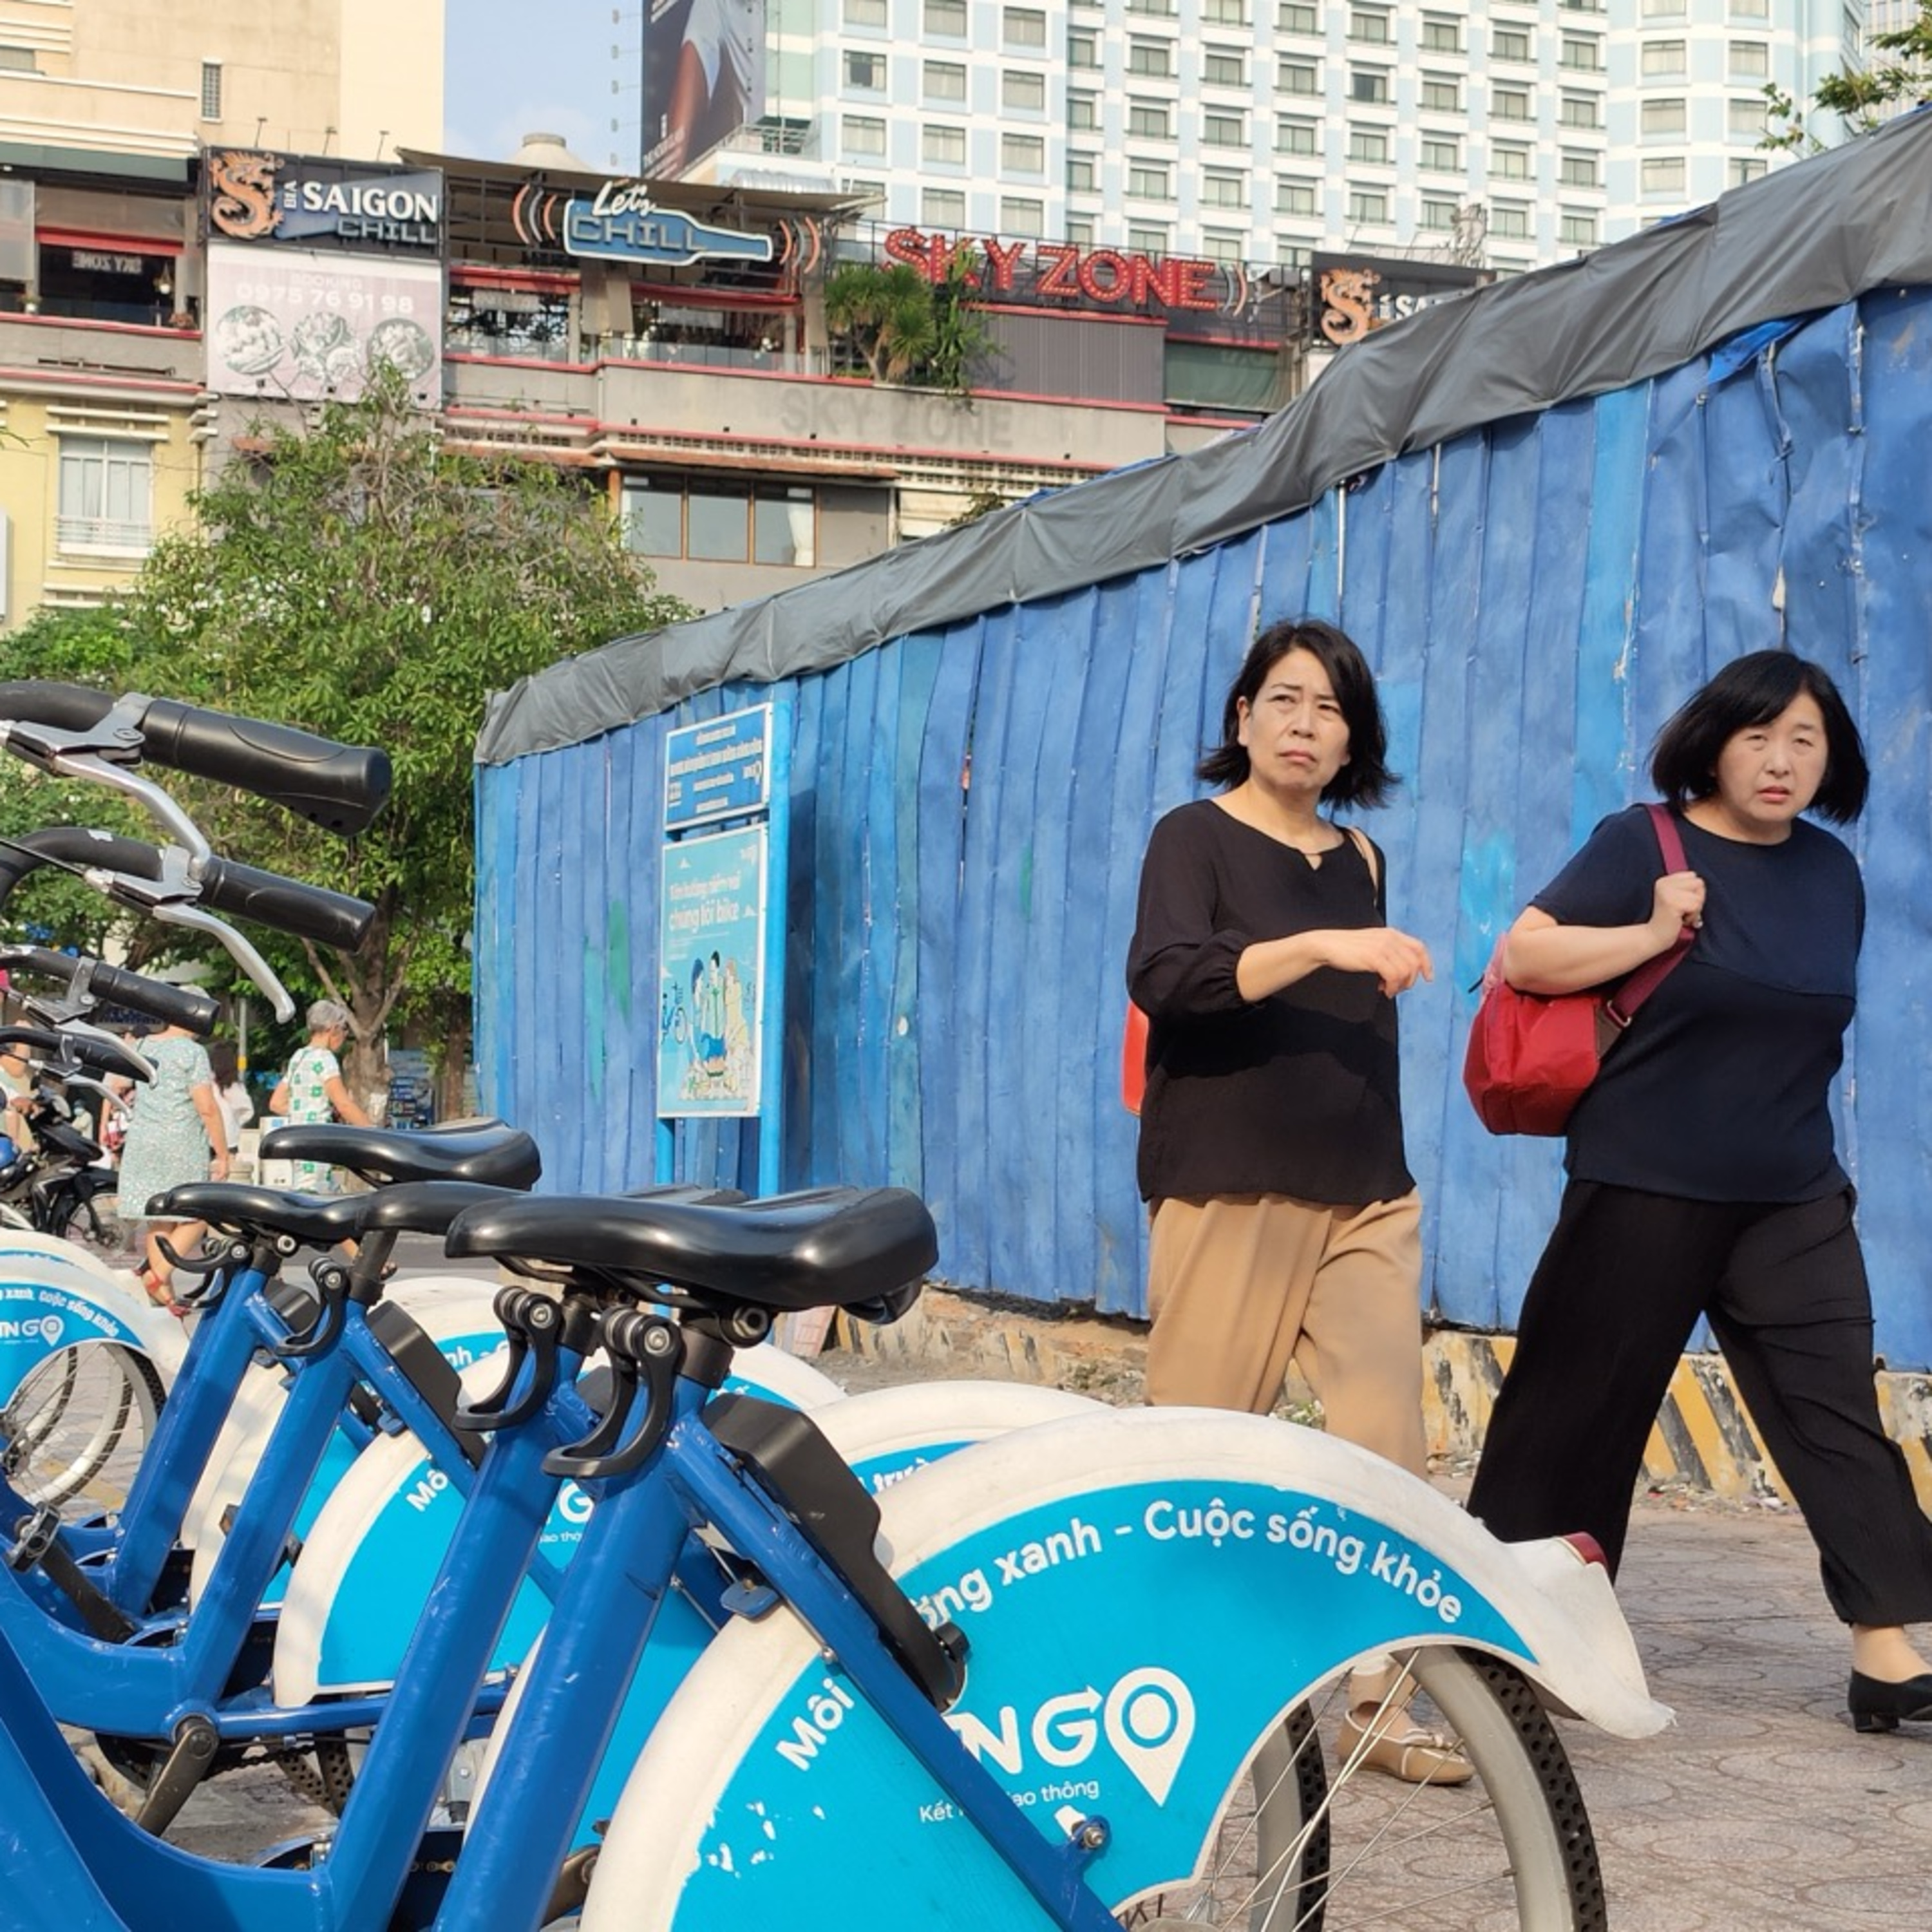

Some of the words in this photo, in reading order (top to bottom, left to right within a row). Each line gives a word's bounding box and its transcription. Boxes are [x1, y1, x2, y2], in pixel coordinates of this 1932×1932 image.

[303, 181, 437, 222] SAIGON
[337, 218, 437, 244] CHILL
[571, 216, 706, 252] CHILL
[881, 226, 1027, 290] SKY
[1036, 243, 1217, 311] ZONE
[236, 282, 303, 303] 0975
[311, 290, 341, 308] 76
[348, 292, 374, 313] 91
[381, 295, 414, 314] 98
[781, 386, 873, 437] SKY
[891, 394, 1013, 447] ZONE
[406, 1469, 448, 1513] Mô
[775, 1678, 855, 1772] Môi
[993, 1517, 1102, 1586] xanh
[1144, 1497, 1255, 1547] Cuộc
[1266, 1506, 1365, 1575] sống
[1370, 1542, 1463, 1624] khỏe
[919, 1800, 954, 1823] Kết
[1041, 1780, 1099, 1803] thông
